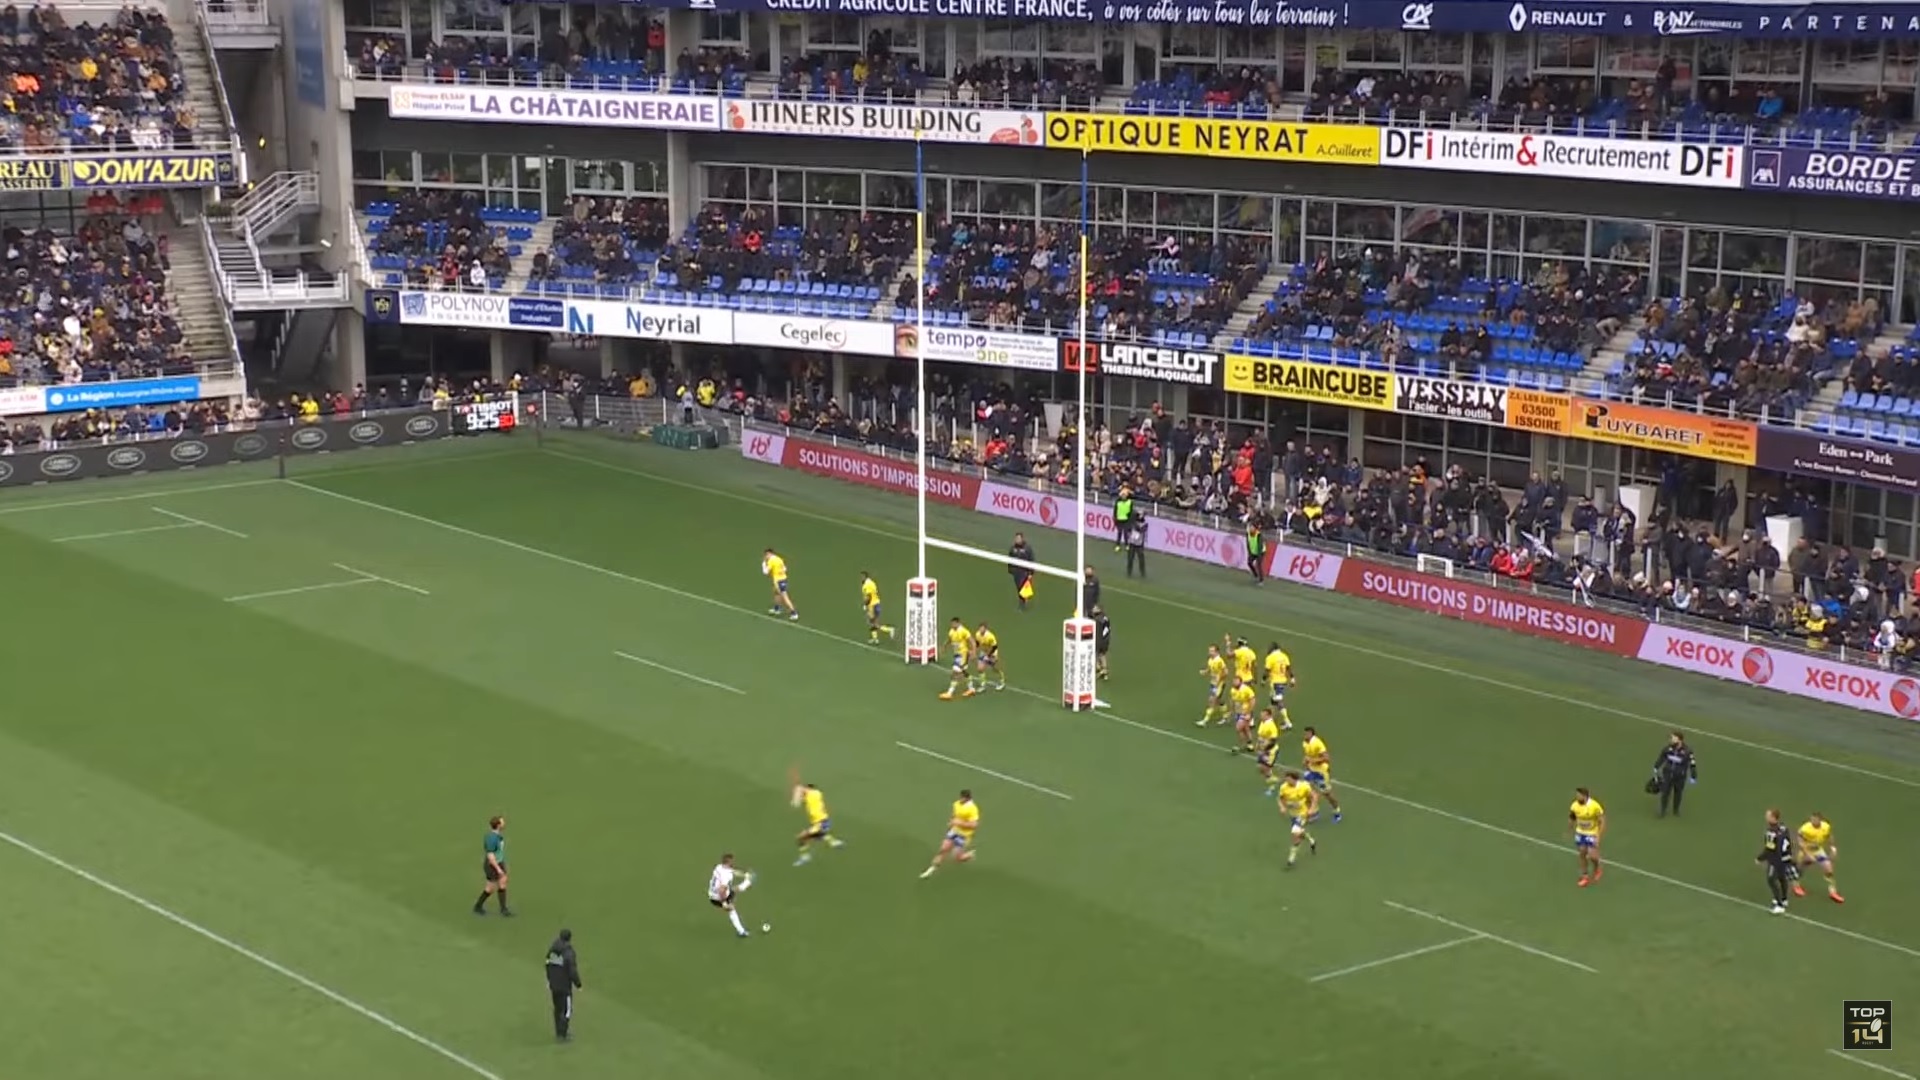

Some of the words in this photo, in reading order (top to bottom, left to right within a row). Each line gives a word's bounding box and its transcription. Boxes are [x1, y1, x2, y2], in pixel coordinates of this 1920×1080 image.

[839, 0, 929, 13] AGRICOLE
[936, 0, 1007, 16] CENTRE
[1015, 0, 1093, 21] FRANCE,
[1104, 1, 1115, 19] à
[1119, 3, 1142, 21] vos
[1147, 0, 1181, 22] côtés
[1186, 4, 1211, 23] sur
[1215, 0, 1245, 24] tous
[1250, 1, 1272, 24] les
[1276, 1, 1338, 27] terrains
[1343, 3, 1349, 25] !
[1531, 11, 1607, 26] RENAULT
[1623, 14, 1633, 26] &
[412, 102, 442, 112] Hôpital
[444, 102, 465, 111] Privé
[470, 95, 501, 114] LA
[509, 94, 714, 123] CHÂTAIGNERAIE
[751, 101, 855, 128] ITINERIS
[862, 106, 981, 134] BUILDING
[1049, 117, 1181, 147] OPTIQUE
[1195, 124, 1308, 155] NEYRAT
[1386, 129, 1433, 160] DFi
[1442, 135, 1514, 161] Intérim
[1517, 134, 1538, 166] &
[1543, 140, 1671, 171] Recrutement
[1680, 144, 1735, 179] DFi
[1805, 153, 1916, 181] BORDE
[73, 157, 215, 184] DOM'AZUR
[1787, 175, 1884, 195] ASSURANCES
[1889, 183, 1906, 196] ET
[431, 295, 505, 314] POLYNOV
[626, 306, 701, 336] Neyrial
[780, 322, 842, 345] Cegelec
[927, 328, 987, 349] tempo
[1100, 343, 1219, 385] LANCELOT
[1101, 363, 1205, 384] THERMOLAQUAGE
[1253, 361, 1387, 399] BRAINCUBE
[67, 394, 79, 402] La
[80, 392, 115, 403] Région
[472, 401, 512, 413] TISSOT
[1397, 376, 1506, 413] VESSELY
[1524, 392, 1539, 402] LES
[1541, 395, 1569, 407] LISTES
[1409, 399, 1439, 413] l'acier
[1447, 404, 1462, 416] les
[1464, 408, 1493, 421] outils
[1515, 415, 1562, 432] ISSOIRE
[1521, 403, 1556, 418] 63500
[1584, 405, 1704, 445] PUYBARET
[798, 447, 869, 478] SOLUTIONS
[1818, 441, 1848, 458] Eden
[1864, 448, 1894, 466] Park
[992, 489, 1036, 515] xerox
[1164, 526, 1216, 555] xerox
[1362, 571, 1468, 610] SOLUTIONS
[1472, 594, 1616, 645] D'IMPRESSION
[1666, 636, 1735, 669] xerox
[1805, 666, 1881, 701] xerox
